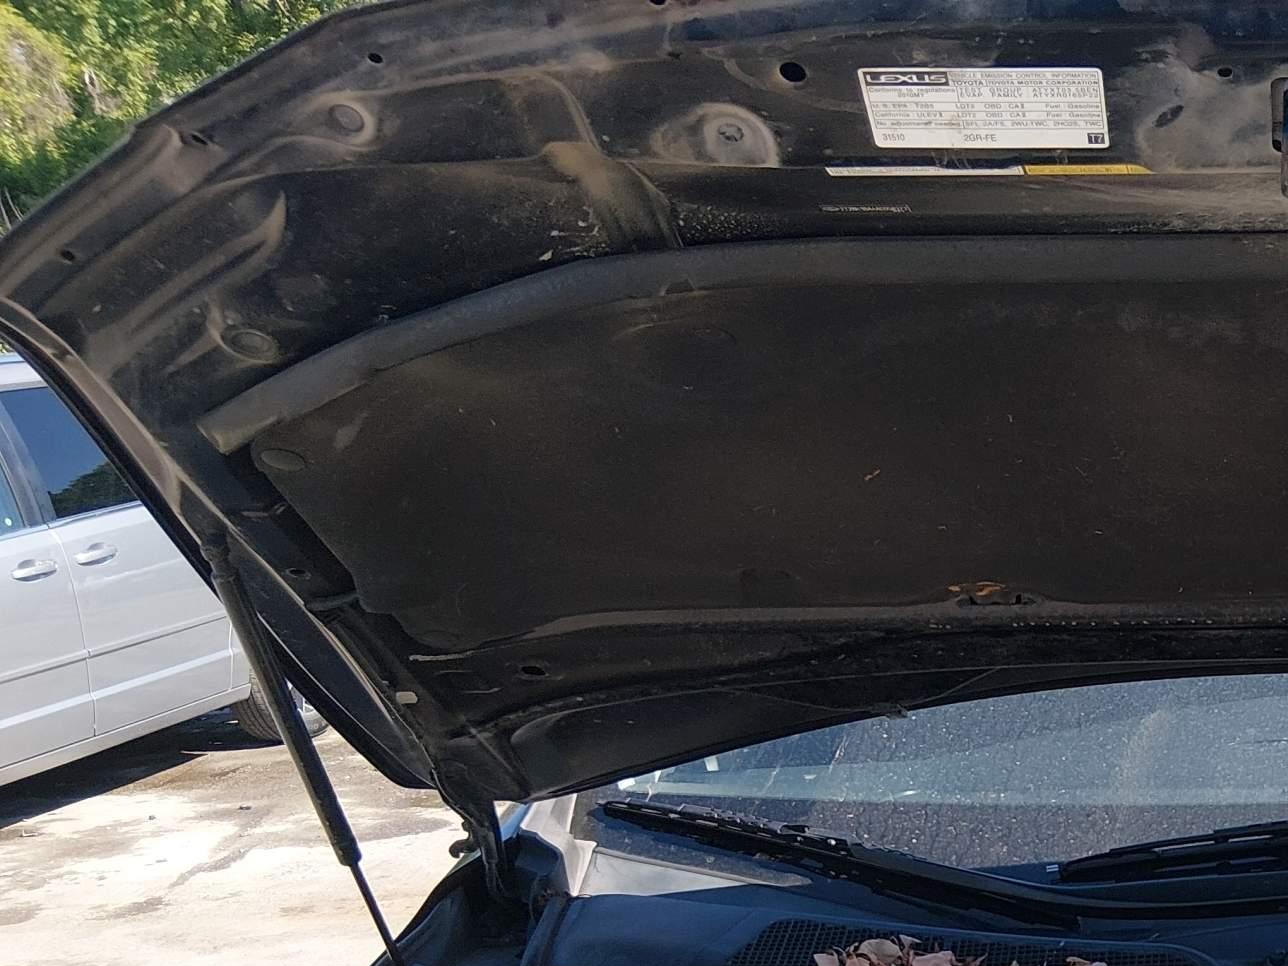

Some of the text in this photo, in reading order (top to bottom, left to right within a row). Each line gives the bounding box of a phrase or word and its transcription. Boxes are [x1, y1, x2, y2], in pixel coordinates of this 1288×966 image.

[866, 74, 947, 83] LEXUS
[881, 133, 905, 142] 31510
[963, 133, 998, 142] 2GR-FE
[1092, 135, 1104, 143] T7
